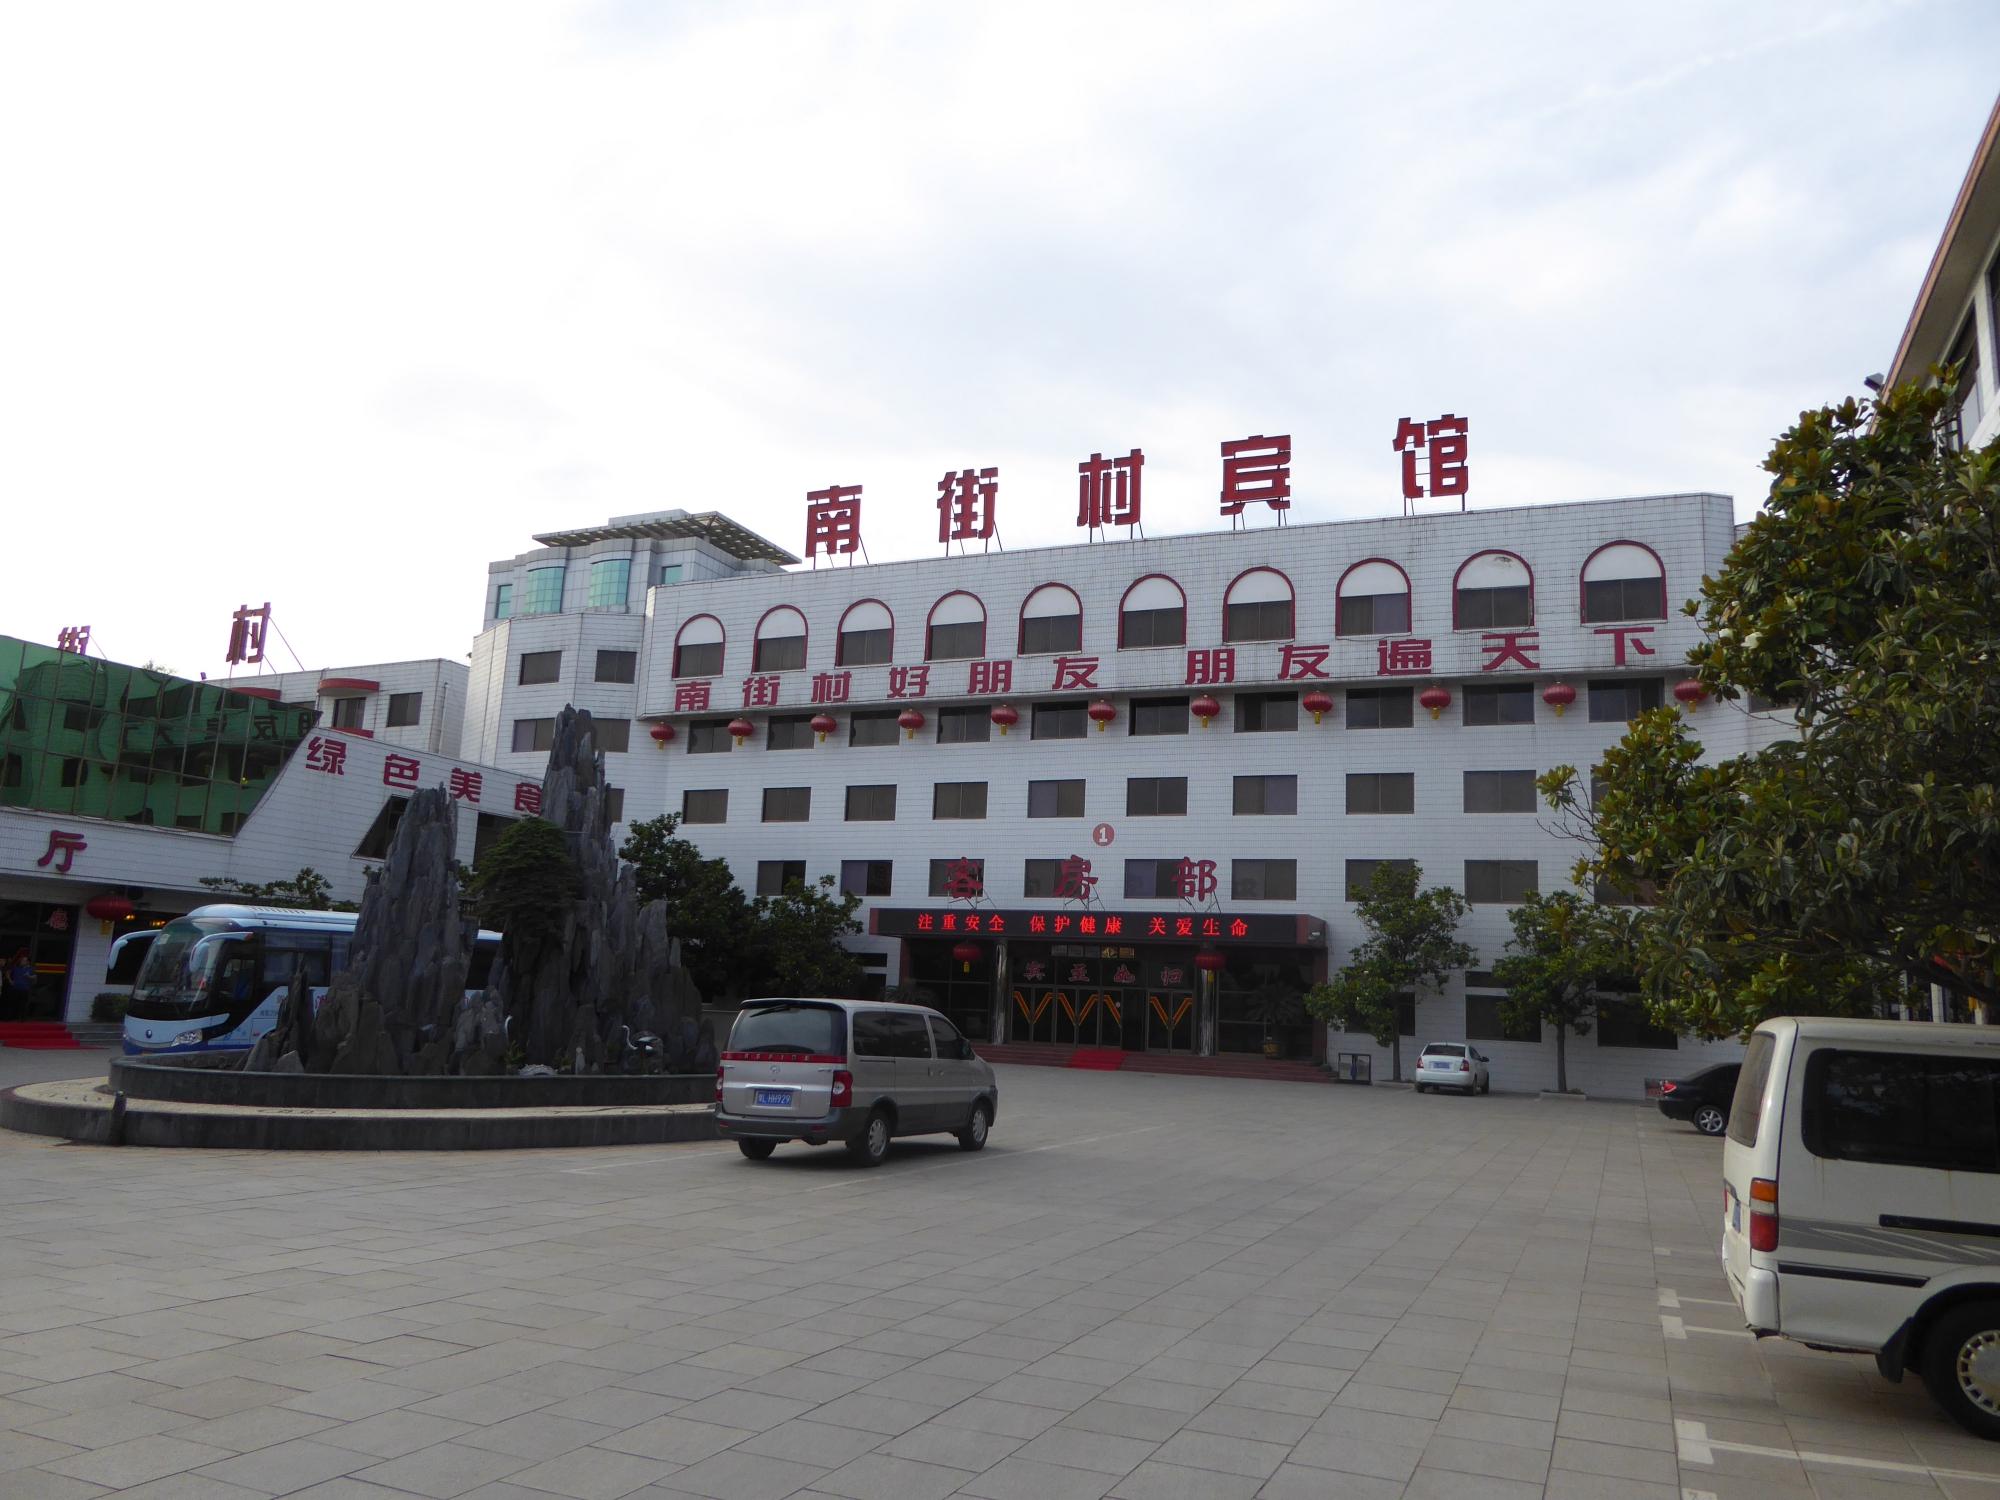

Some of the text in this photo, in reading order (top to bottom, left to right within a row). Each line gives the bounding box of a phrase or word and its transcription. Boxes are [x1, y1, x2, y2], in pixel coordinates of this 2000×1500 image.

[805, 413, 1469, 558] 南街村宾馆
[674, 626, 1656, 713] 南街村好朋友 朋友遍天下
[305, 736, 543, 816] 绿色美食
[37, 829, 88, 873] 厅
[943, 855, 1218, 902] 客房部
[917, 913, 1249, 938] 注重安全 保护健康 关爱生命
